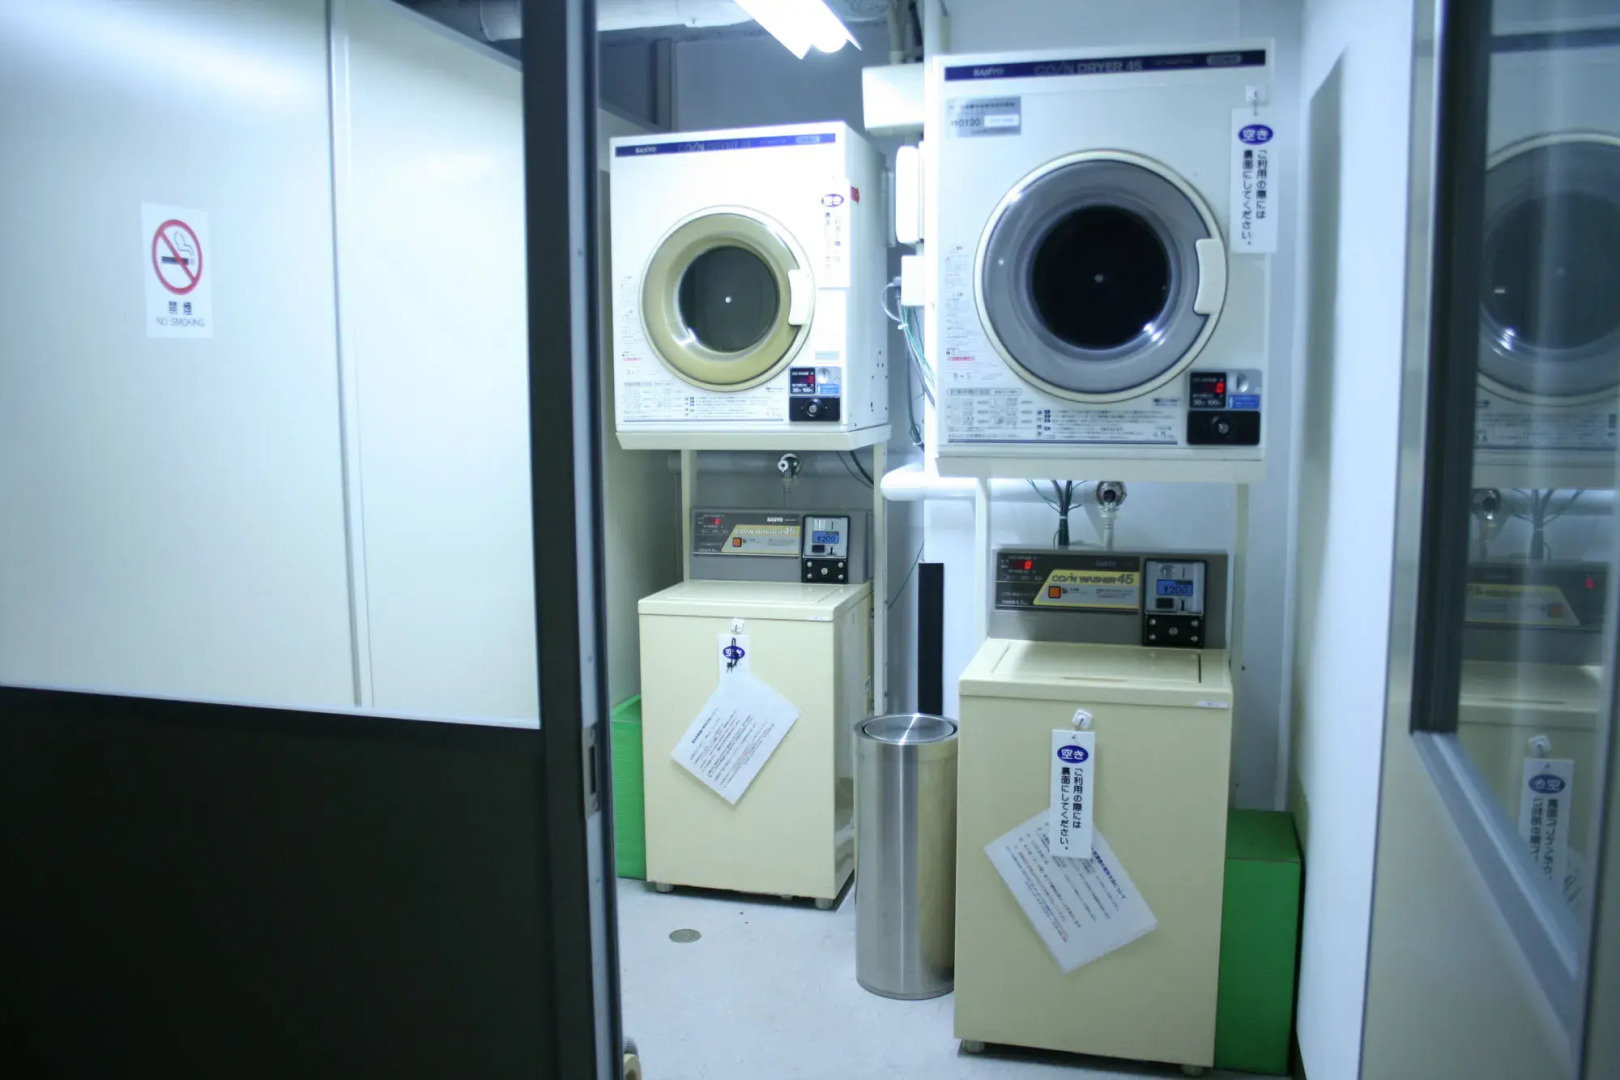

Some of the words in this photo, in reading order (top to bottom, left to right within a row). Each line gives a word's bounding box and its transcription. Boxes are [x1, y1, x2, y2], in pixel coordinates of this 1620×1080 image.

[972, 68, 1005, 77] SANYO
[1076, 61, 1123, 74] DRYER
[1125, 60, 1144, 72] 45
[1242, 128, 1269, 141] 空き
[1255, 149, 1268, 220] ご利用の際には
[156, 316, 168, 326] NO
[170, 317, 206, 327] SMOKING
[1215, 382, 1224, 393] 0
[1023, 560, 1032, 570] 0
[1079, 575, 1116, 585] WASHER
[1116, 573, 1134, 585] 45
[1061, 748, 1084, 760] 空き
[1072, 767, 1083, 829] ご利用の際には
